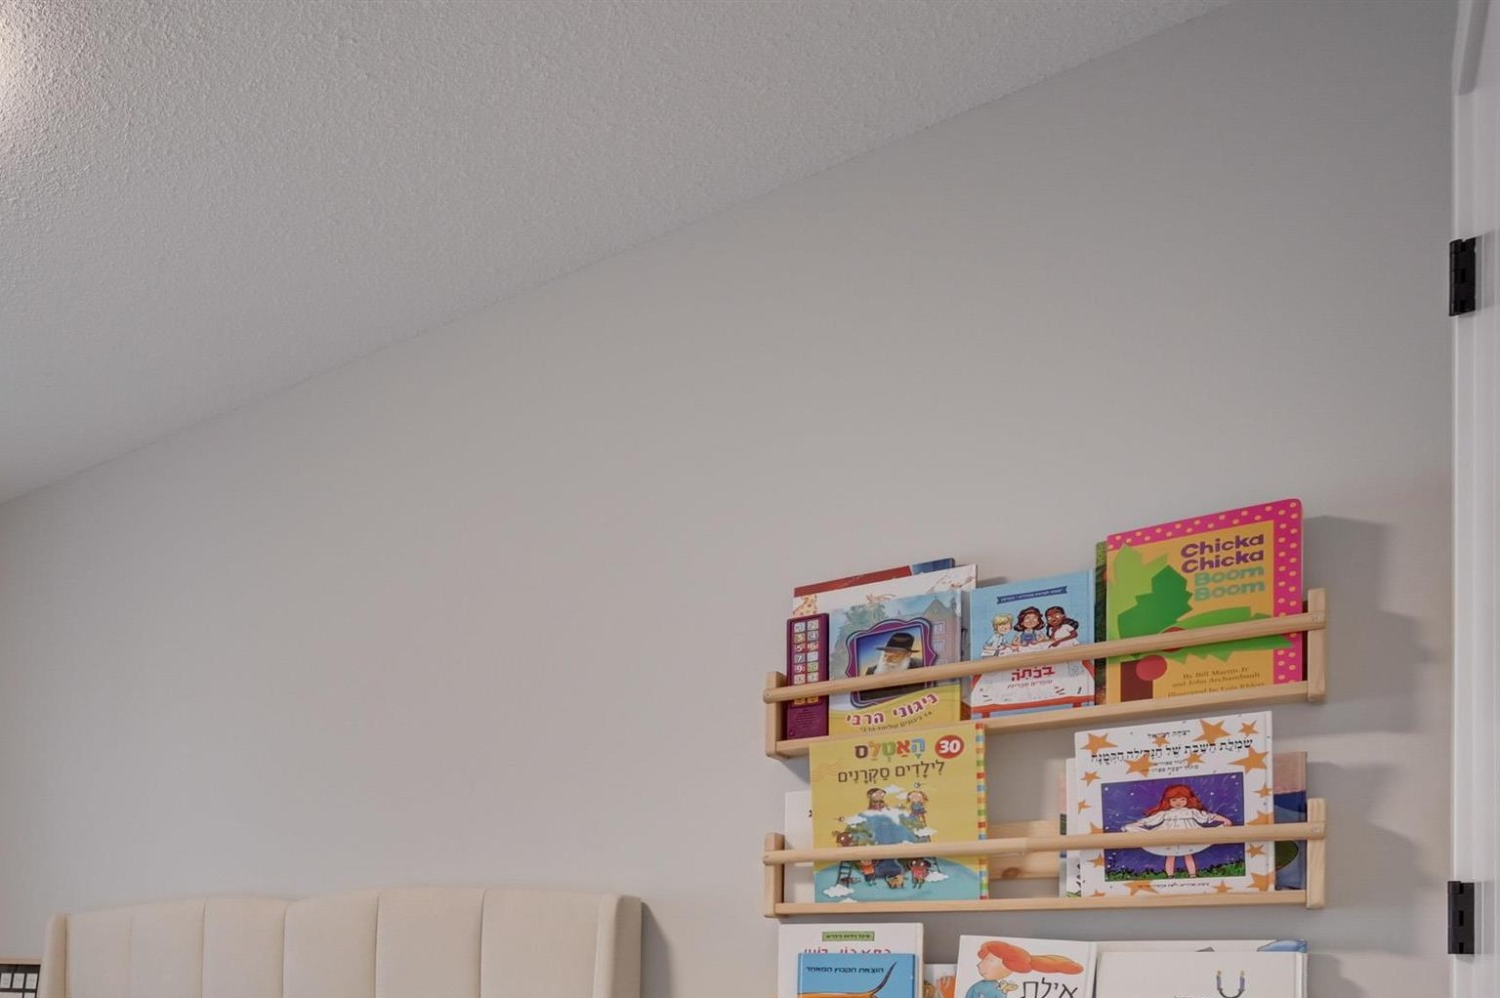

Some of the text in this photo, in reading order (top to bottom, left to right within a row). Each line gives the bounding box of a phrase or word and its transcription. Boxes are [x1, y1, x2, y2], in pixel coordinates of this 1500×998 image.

[1181, 534, 1264, 558] Chicka
[1181, 550, 1264, 573] Chicka
[1195, 566, 1264, 586] Boom
[1195, 581, 1265, 601] Boom
[939, 739, 961, 754] 30
